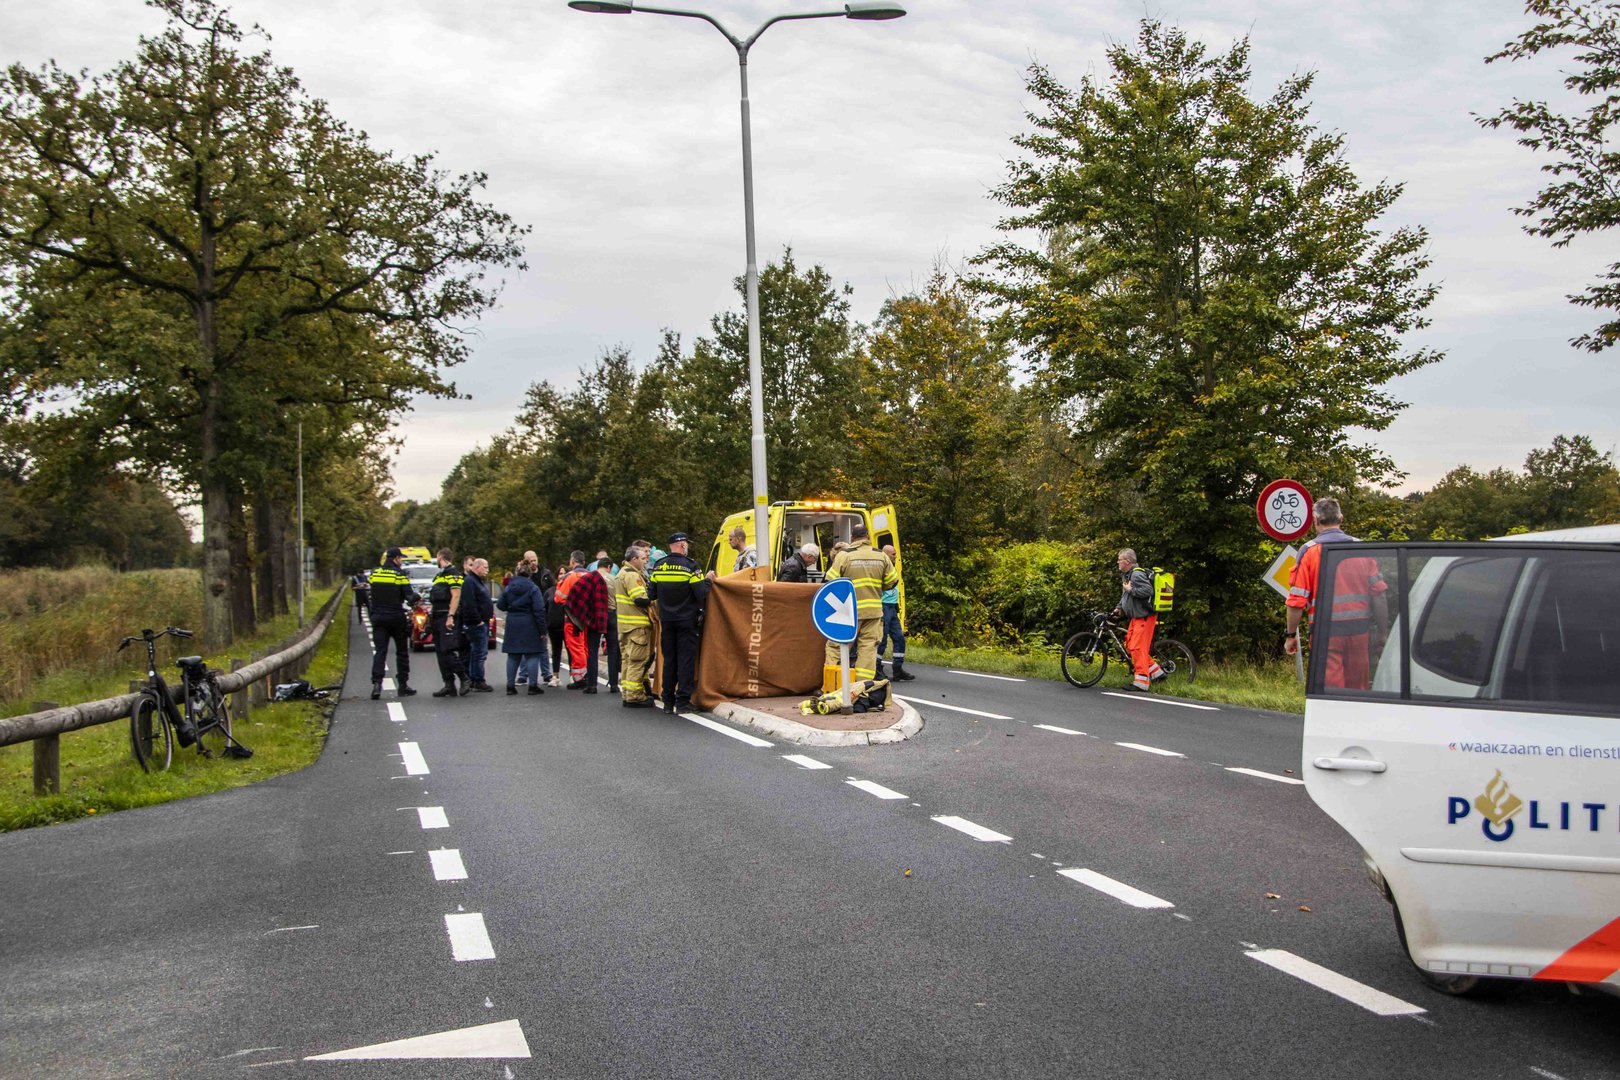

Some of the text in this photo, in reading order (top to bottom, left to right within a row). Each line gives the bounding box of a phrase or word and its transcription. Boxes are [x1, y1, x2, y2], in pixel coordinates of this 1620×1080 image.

[749, 583, 763, 678] RIJKSPOLITIE
[1460, 742, 1541, 756] waakzaam
[1545, 747, 1564, 757] en
[1569, 745, 1620, 760] dienst
[1448, 796, 1620, 842] POLIT
